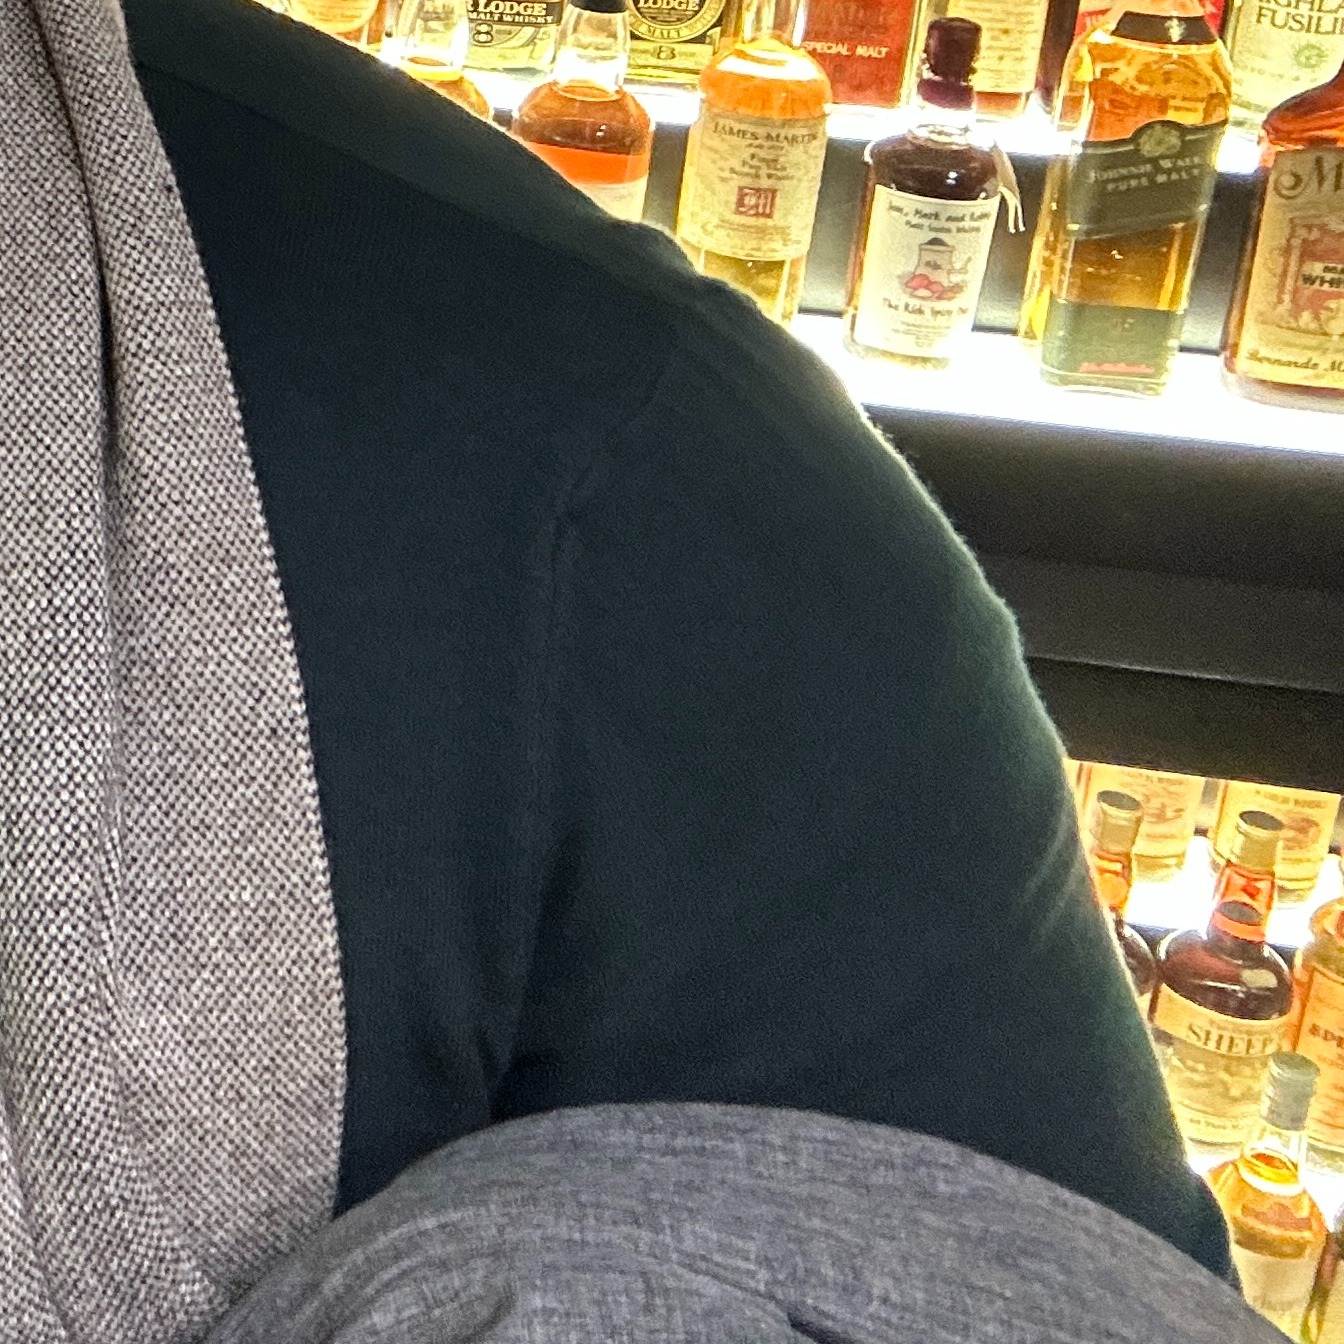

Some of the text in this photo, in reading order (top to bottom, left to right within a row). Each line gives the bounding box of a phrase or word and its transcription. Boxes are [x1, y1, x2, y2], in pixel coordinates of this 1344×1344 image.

[477, 0, 548, 16] LODGE
[502, 13, 554, 24] WHISKY
[471, 22, 494, 45] 8
[855, 45, 890, 59] MALT
[712, 120, 760, 142] JAMES
[1154, 167, 1201, 185] MALT
